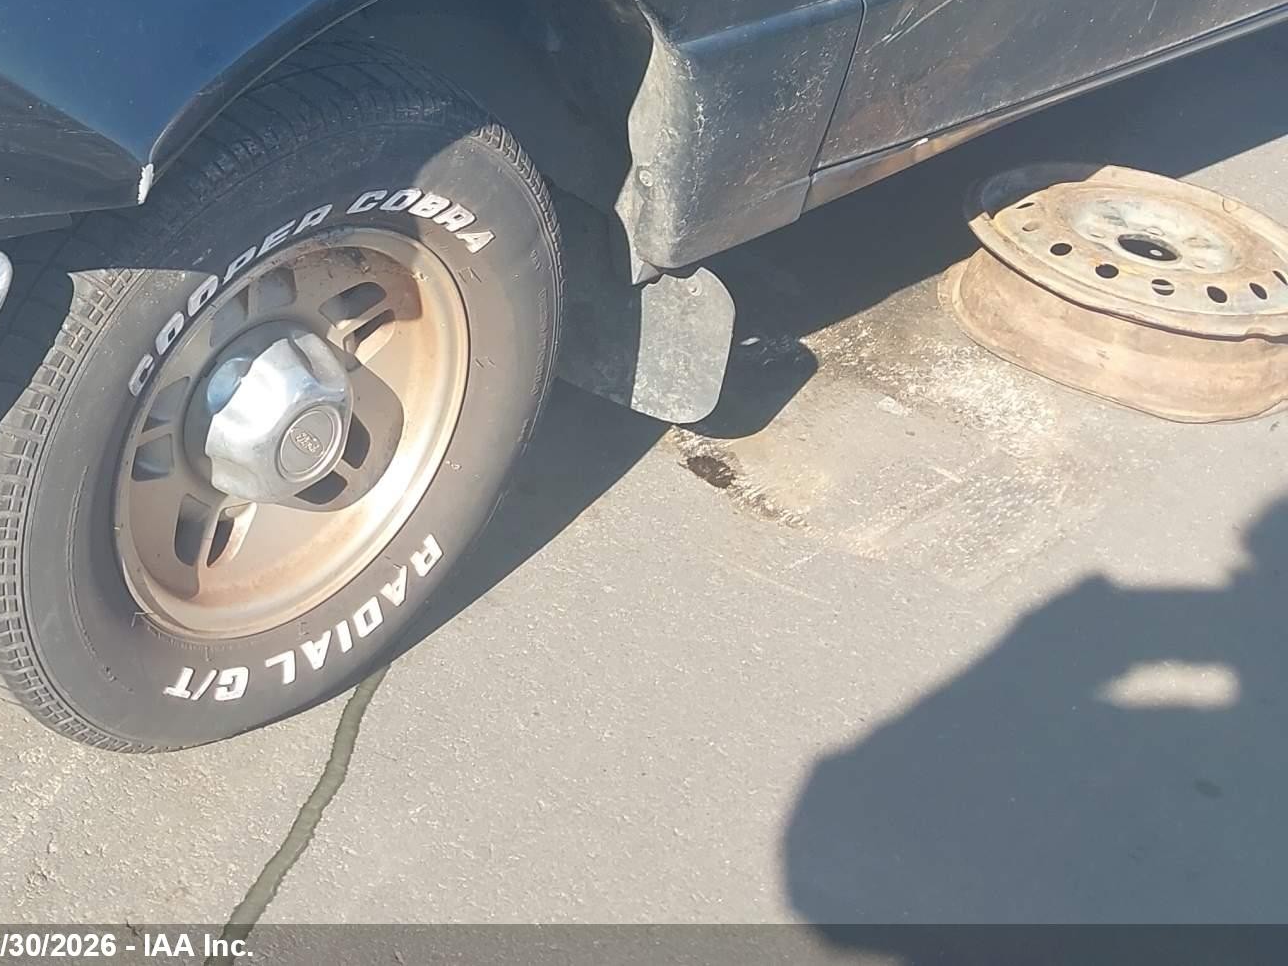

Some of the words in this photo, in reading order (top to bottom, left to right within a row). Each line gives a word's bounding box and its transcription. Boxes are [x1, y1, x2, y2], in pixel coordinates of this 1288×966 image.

[128, 203, 334, 397] COOPER
[346, 187, 496, 254] COBRA
[162, 666, 250, 702] G/T
[264, 534, 444, 684] RADIAL
